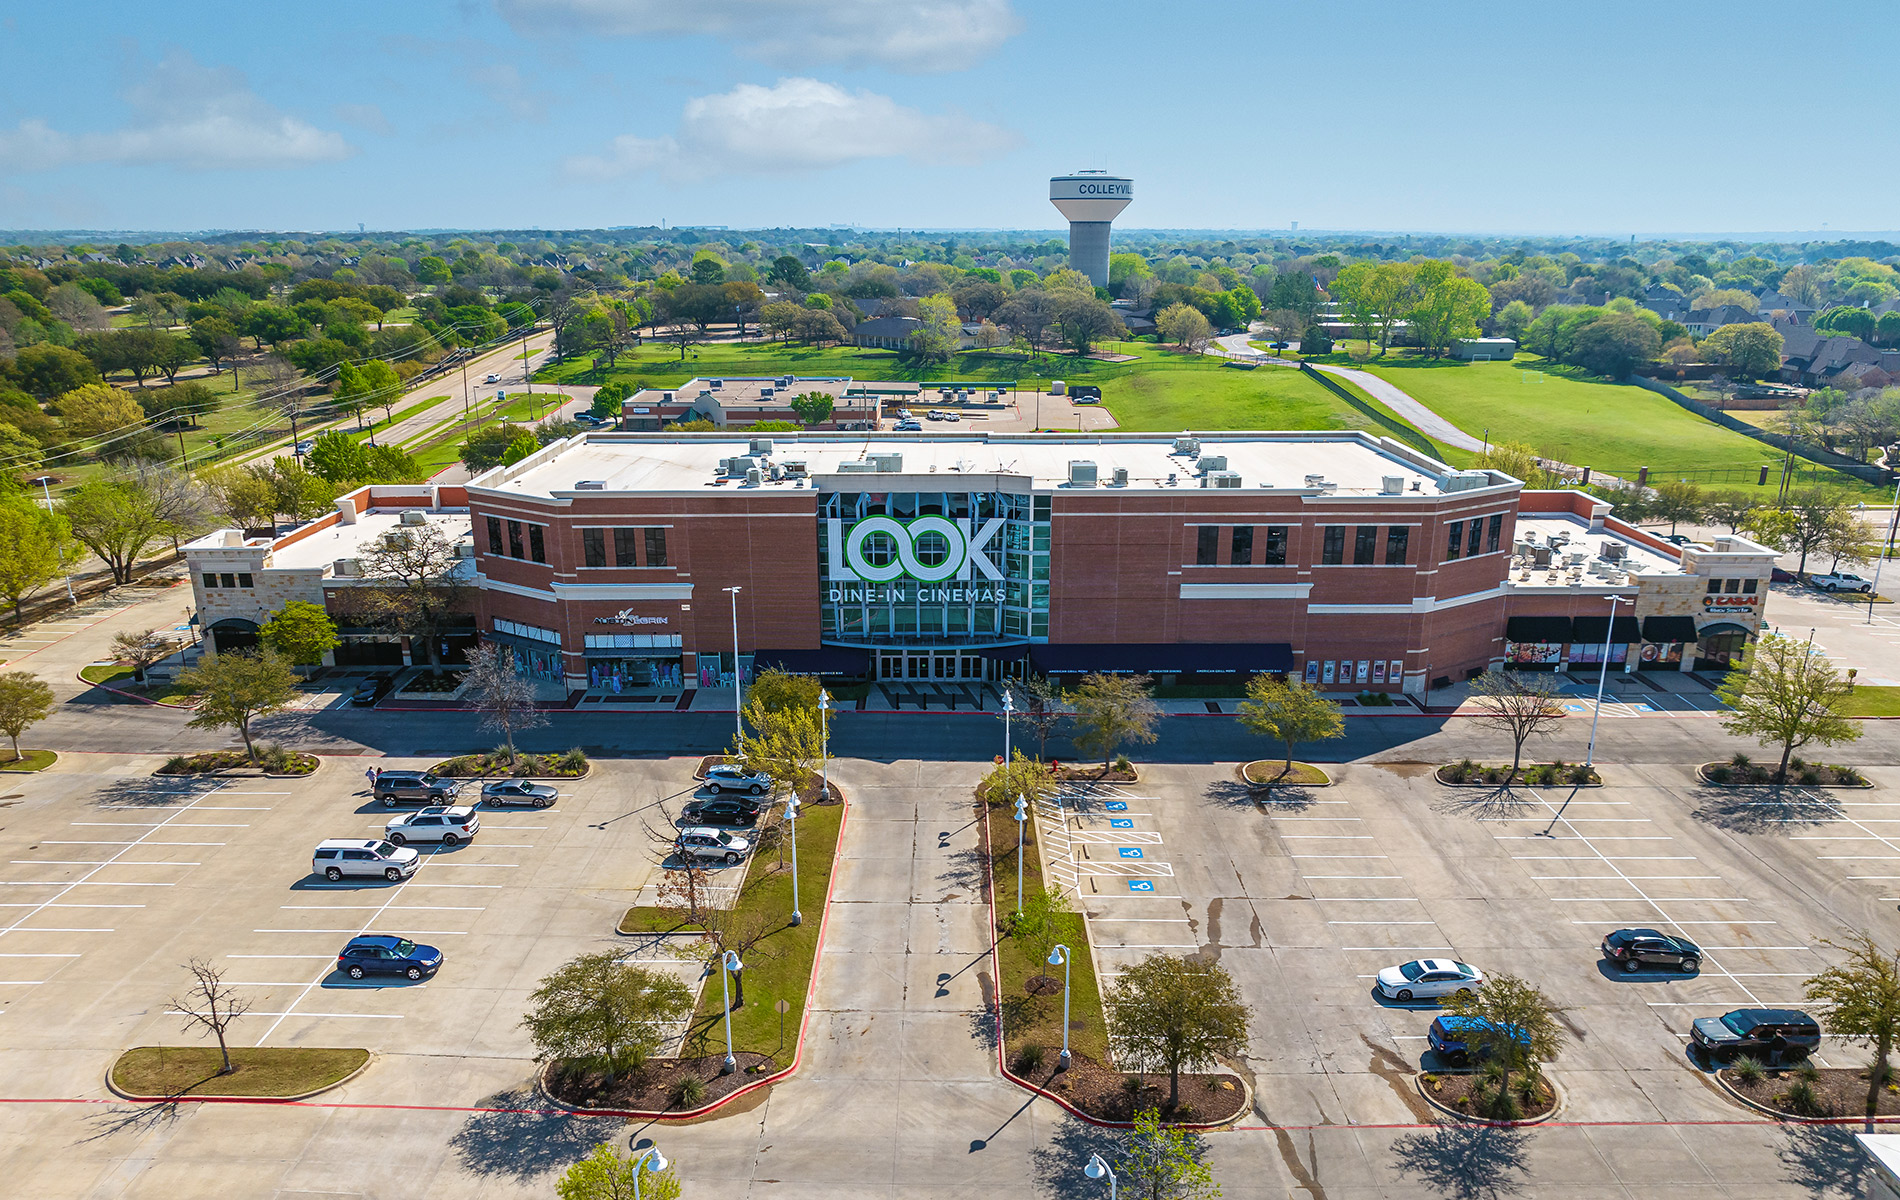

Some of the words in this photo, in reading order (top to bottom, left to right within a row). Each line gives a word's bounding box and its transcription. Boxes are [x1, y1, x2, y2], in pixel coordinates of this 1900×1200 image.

[828, 514, 1006, 583] LOOK
[829, 588, 905, 602] DINE-IN
[917, 588, 1006, 602] CINEMAS
